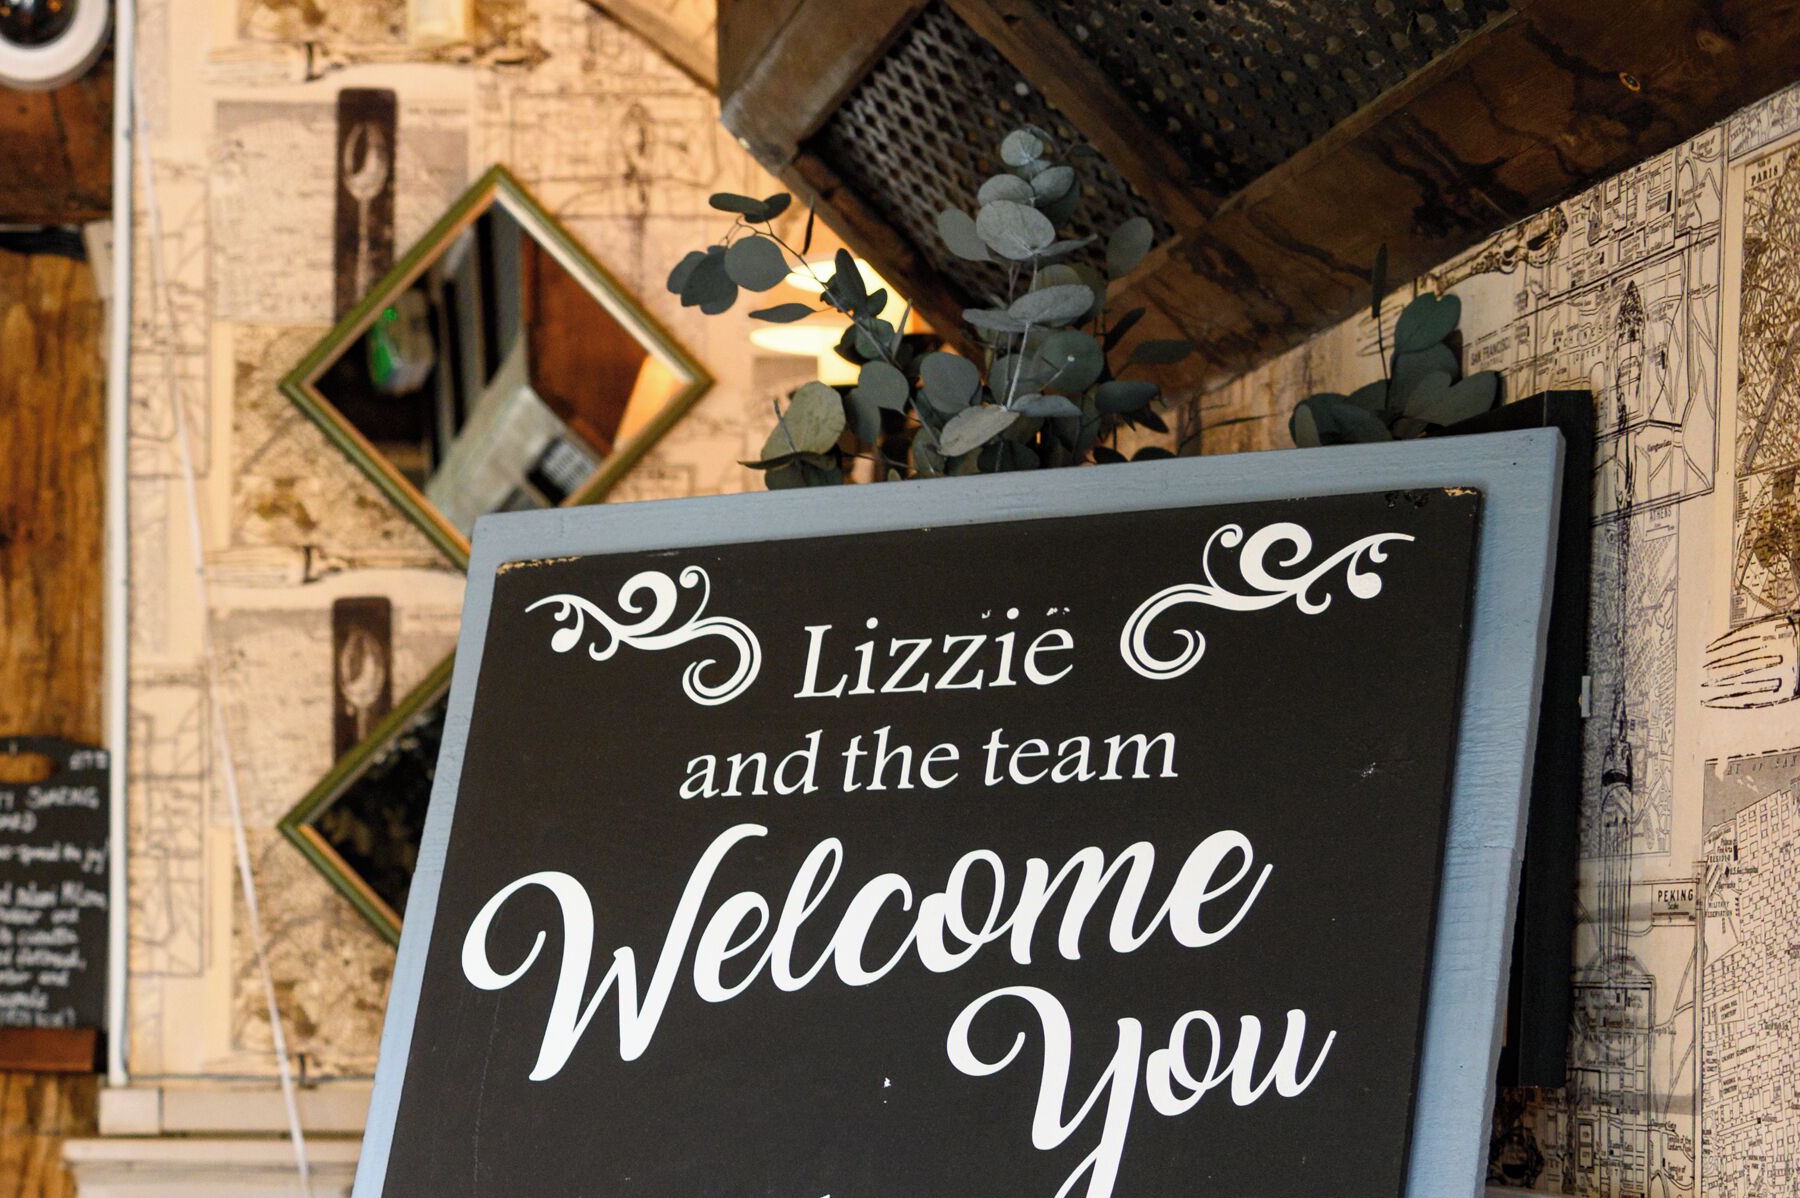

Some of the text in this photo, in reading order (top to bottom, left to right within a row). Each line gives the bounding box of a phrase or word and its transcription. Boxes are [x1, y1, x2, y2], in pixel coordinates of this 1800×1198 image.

[1750, 165, 1779, 187] PARIS
[679, 724, 1179, 801] and the team
[1657, 889, 1694, 902] PEKING
[459, 822, 1275, 1084] Welcome
